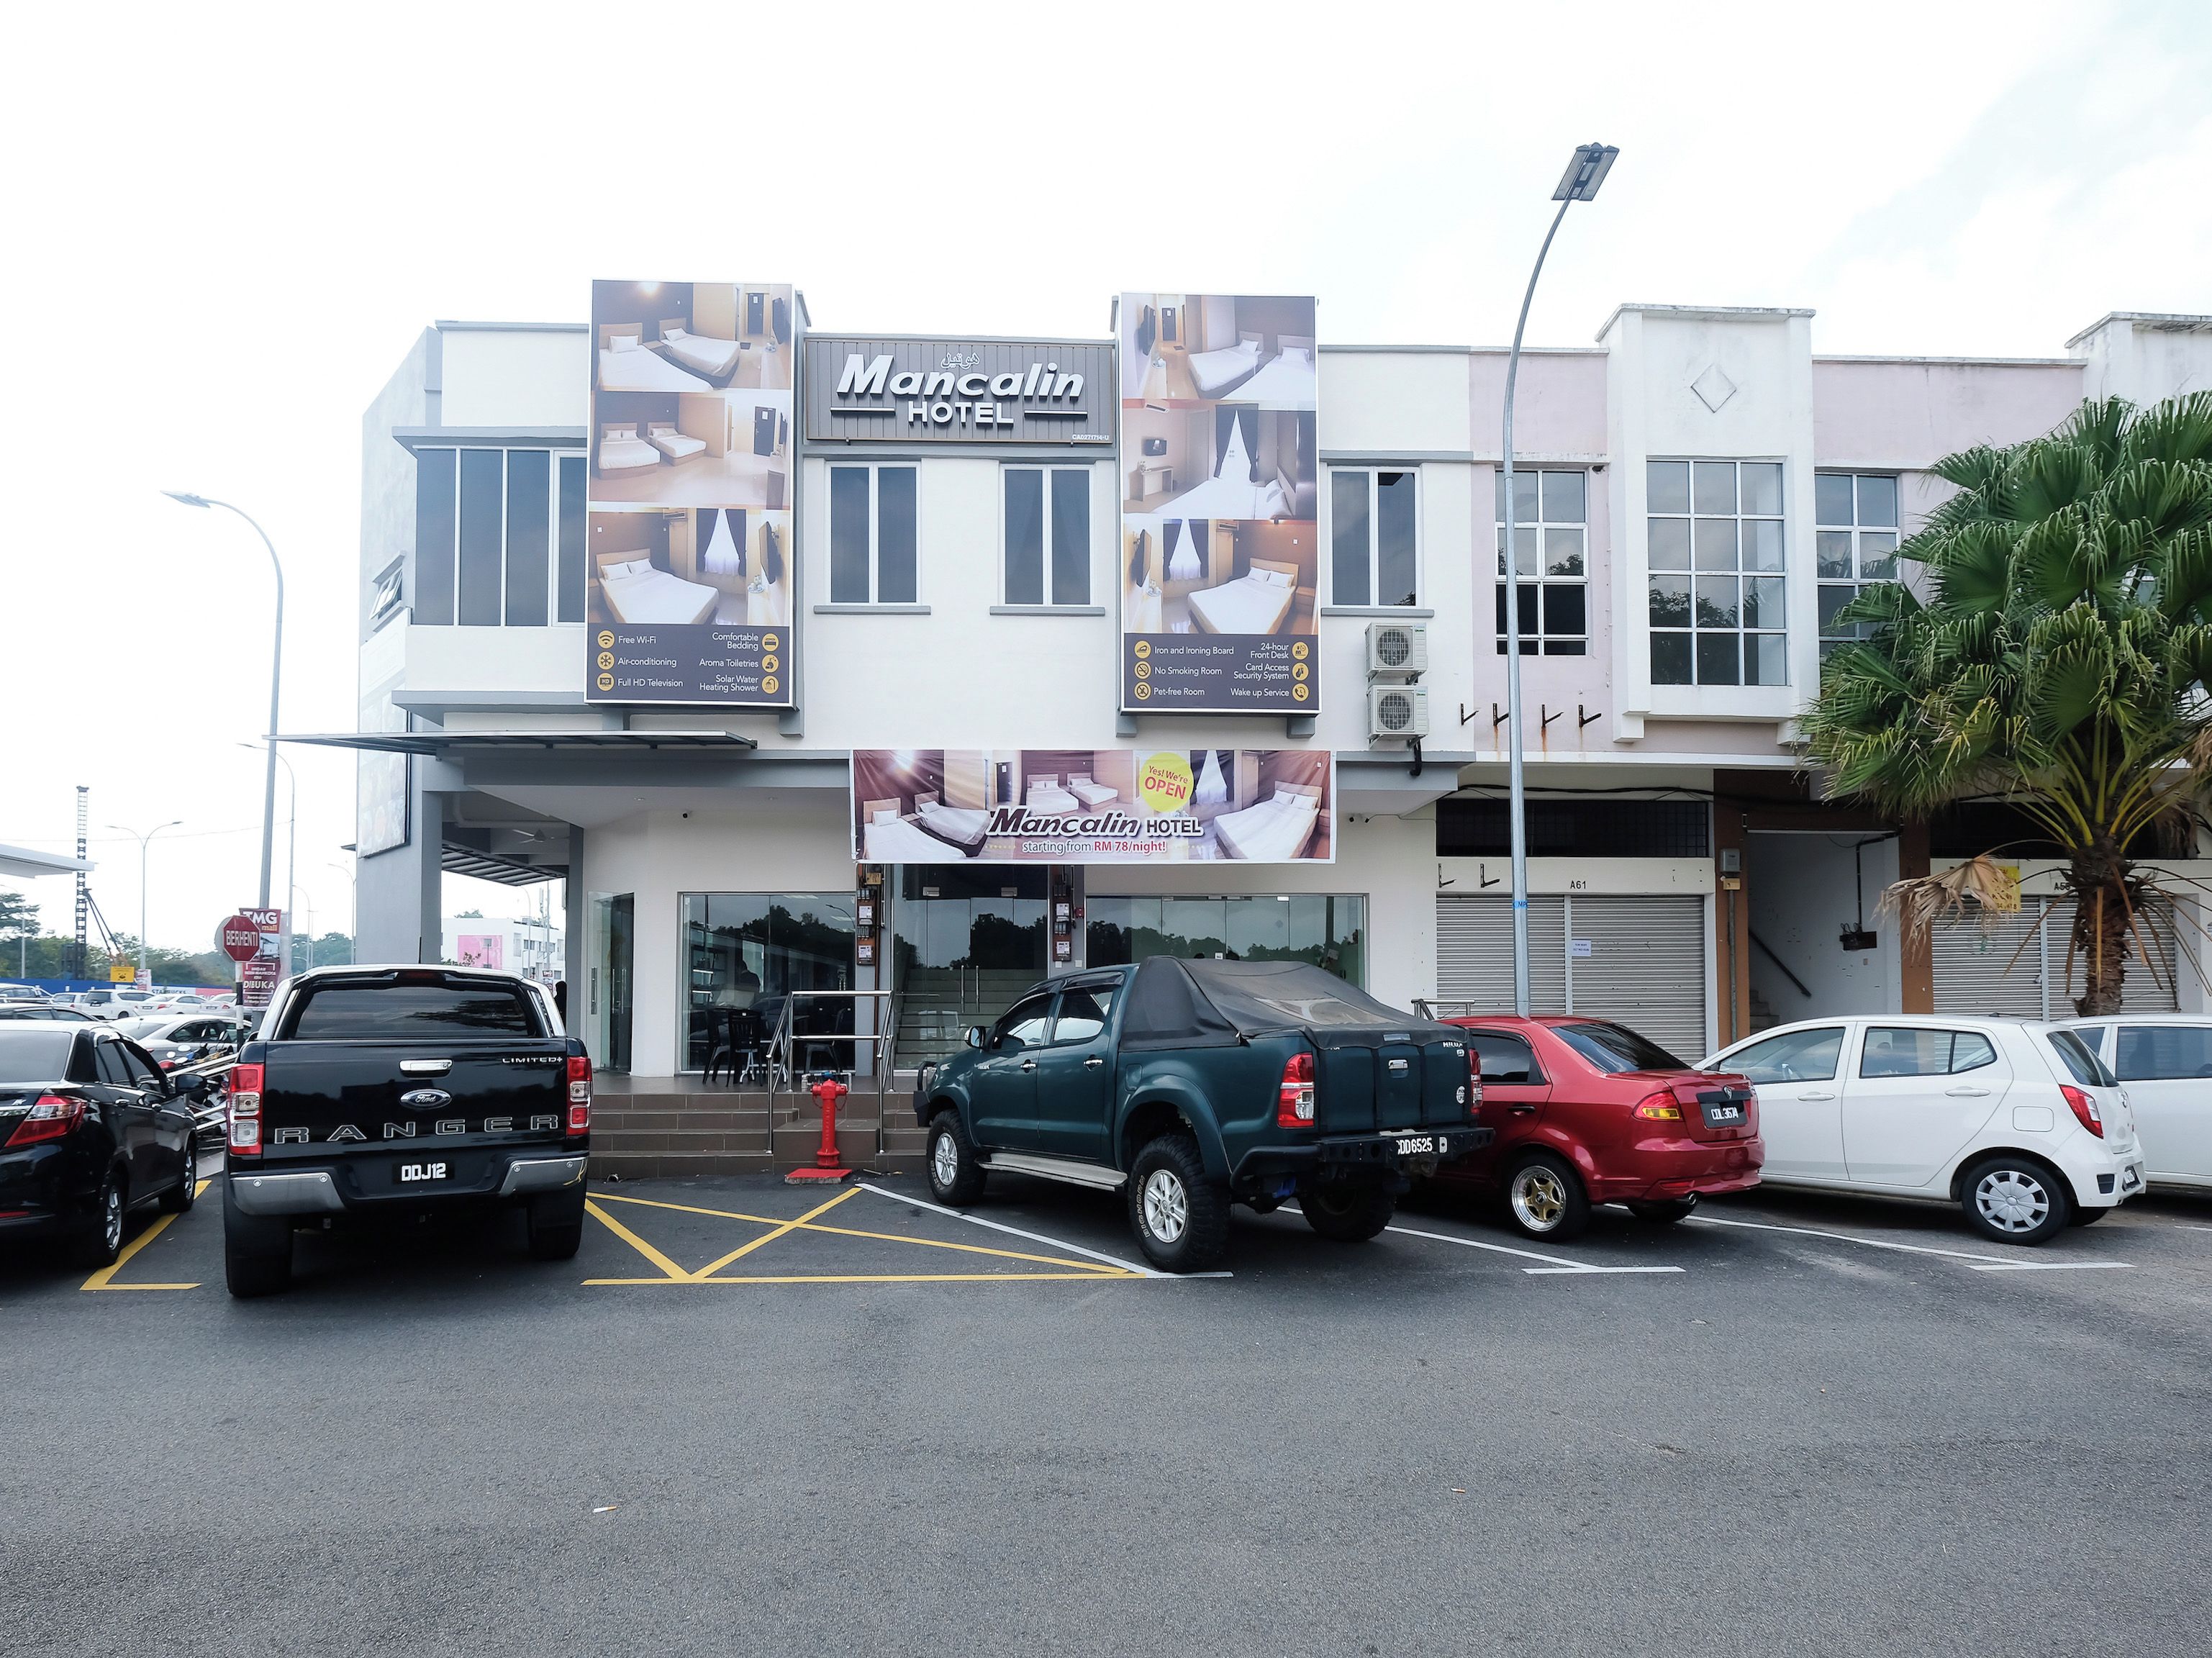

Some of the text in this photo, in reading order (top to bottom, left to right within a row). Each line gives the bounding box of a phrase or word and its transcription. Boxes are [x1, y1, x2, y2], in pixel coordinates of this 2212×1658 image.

[836, 353, 1085, 399] Mancalin
[907, 400, 1015, 427] HOTEL
[618, 635, 657, 644] Free Wi-Fi
[712, 632, 759, 641] Comfortable
[727, 641, 759, 651] Bedding
[1186, 646, 1211, 656] Ironing
[1212, 646, 1234, 655] Board
[1261, 642, 1289, 651] 24-hour
[1250, 651, 1289, 659] Front Desk
[617, 657, 677, 669] Air-conditioning
[699, 658, 759, 668] Aroma Toiletries
[1264, 663, 1289, 671] Access
[1167, 666, 1200, 677] Smoking
[1200, 666, 1223, 675] Room
[1233, 671, 1289, 681] Security System
[617, 678, 684, 687] Full HD Television
[715, 674, 735, 683] Solar
[699, 682, 759, 693] Heating Shower
[1153, 687, 1205, 696] Pet-free Room
[1230, 688, 1289, 699] Wake up Service
[1149, 765, 1188, 784] Yes! We're
[1144, 776, 1187, 799] OPEN
[988, 807, 1202, 834] Mancalin HOTEL
[1023, 840, 1166, 855] starting from RM 78/night!
[1570, 880, 1587, 889] A61
[242, 911, 277, 925] TMG
[226, 930, 258, 946] BERHENTI
[243, 980, 275, 989] DIBUKA
[414, 1093, 438, 1103] Ford
[274, 1115, 559, 1146] RANGER
[401, 1162, 447, 1182] DDJ12
